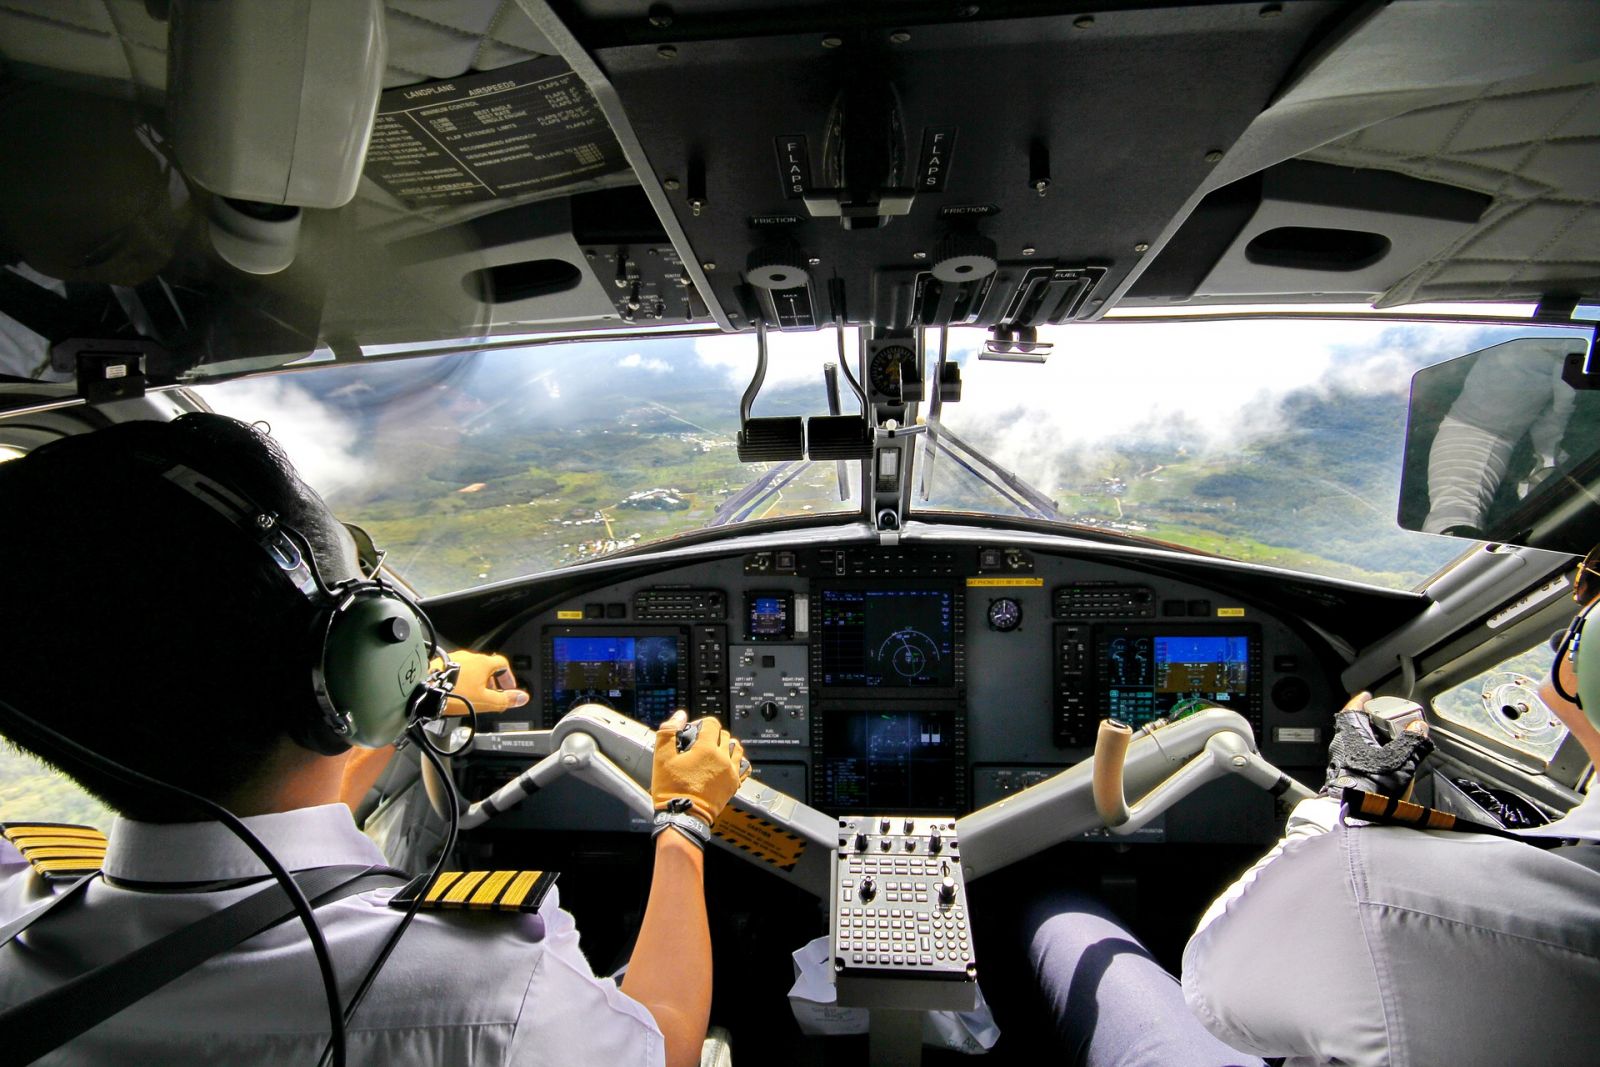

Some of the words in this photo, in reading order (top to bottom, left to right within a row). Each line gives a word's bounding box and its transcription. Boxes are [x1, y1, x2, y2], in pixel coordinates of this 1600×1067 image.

[404, 84, 455, 99] LANDPLANE
[468, 81, 517, 96] AIRSPEEDS
[497, 123, 518, 132] LIMITS
[787, 143, 804, 193] FLAPS
[926, 133, 944, 185] FLAPS
[943, 206, 989, 214] FRICTION
